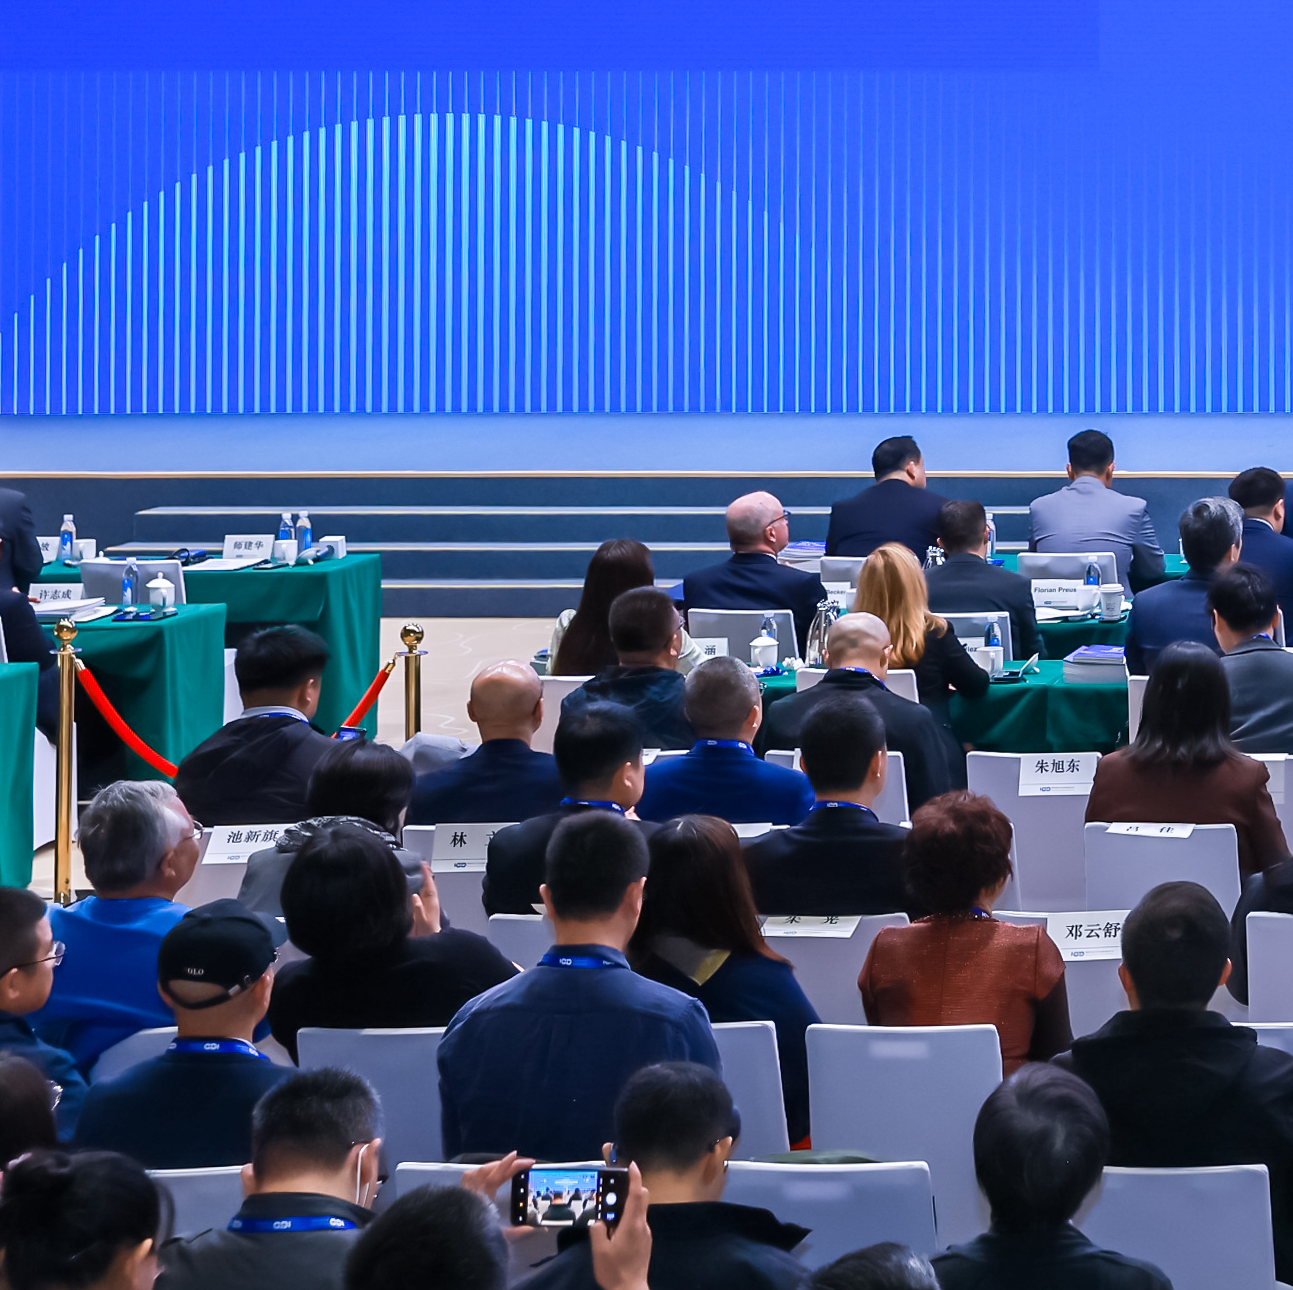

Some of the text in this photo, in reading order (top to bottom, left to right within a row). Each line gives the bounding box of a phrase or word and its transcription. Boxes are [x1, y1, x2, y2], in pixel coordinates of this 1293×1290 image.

[38, 589, 72, 601] 许志成
[1035, 759, 1080, 774] 朱旭东
[226, 828, 279, 844] 池新旗
[450, 831, 467, 848] 林
[1065, 922, 1121, 941] 邓云舒
